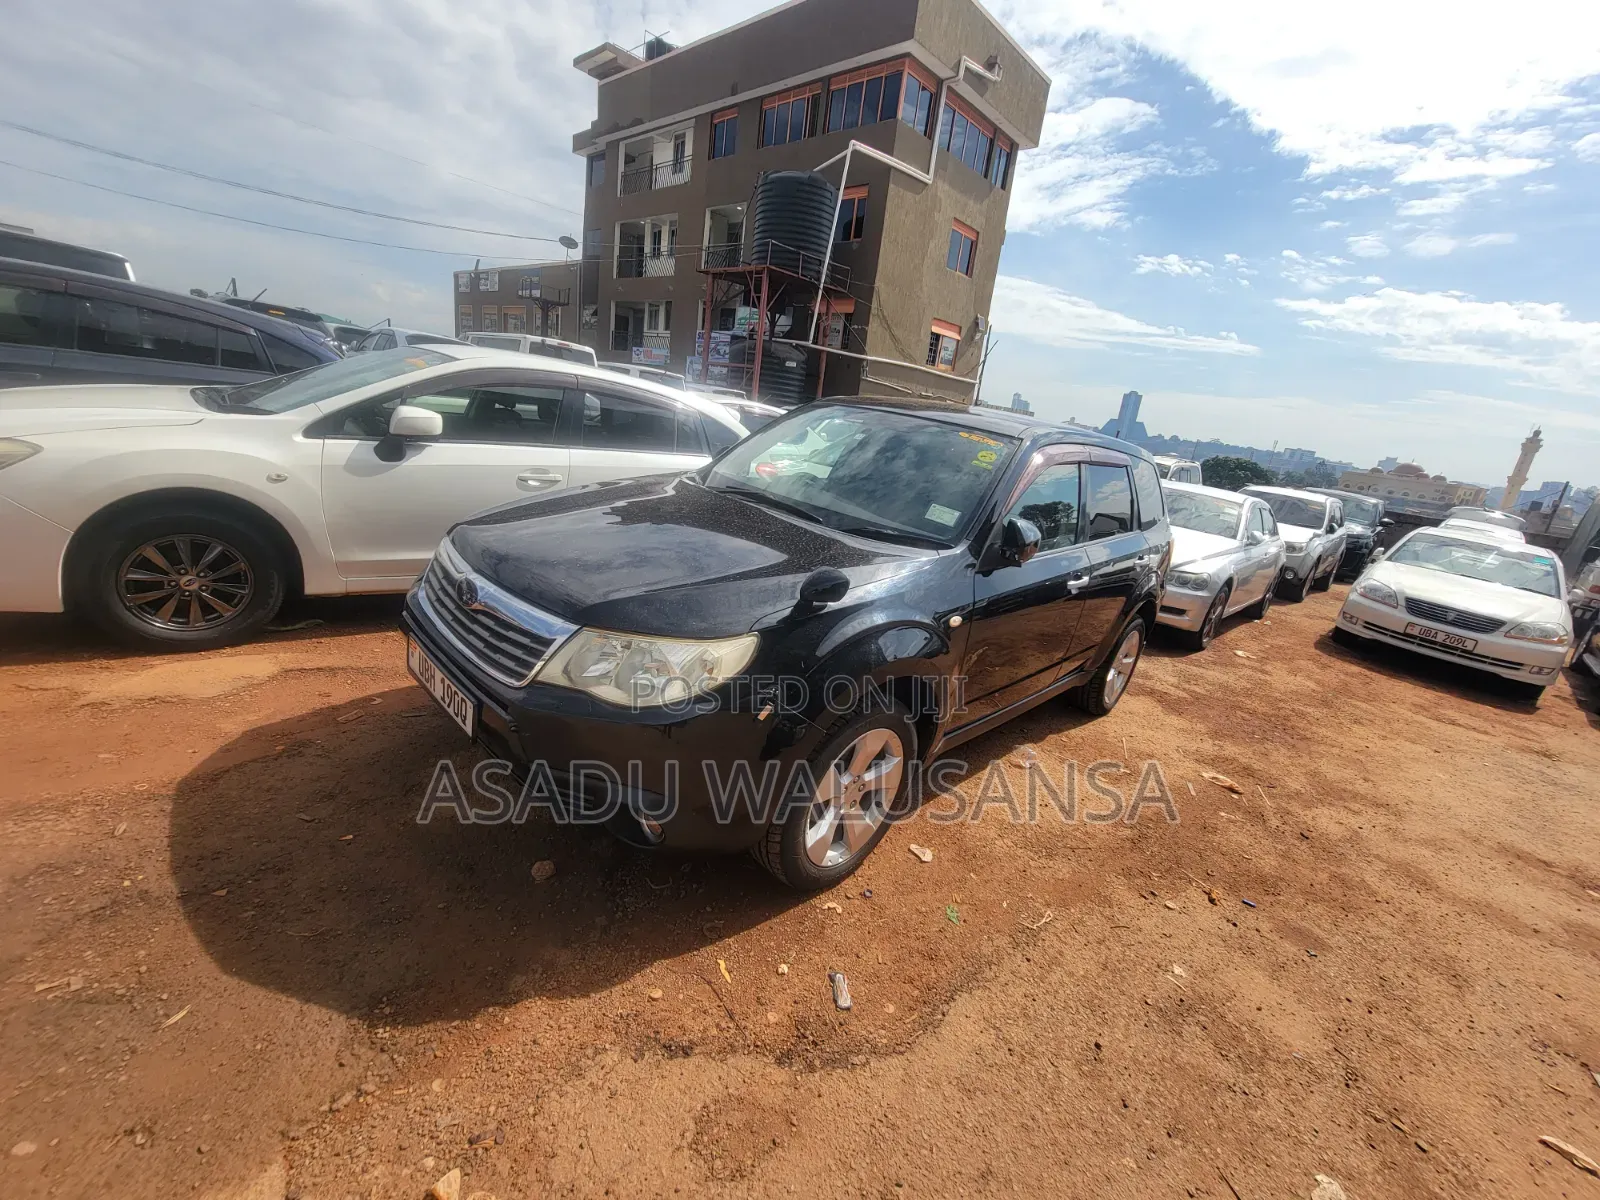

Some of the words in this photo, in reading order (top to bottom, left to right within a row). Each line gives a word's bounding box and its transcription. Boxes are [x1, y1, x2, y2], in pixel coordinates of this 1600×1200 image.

[1418, 627, 1438, 640] UBA
[1442, 634, 1468, 648] 209L
[418, 651, 436, 693] UBH
[440, 677, 468, 727] 190Q
